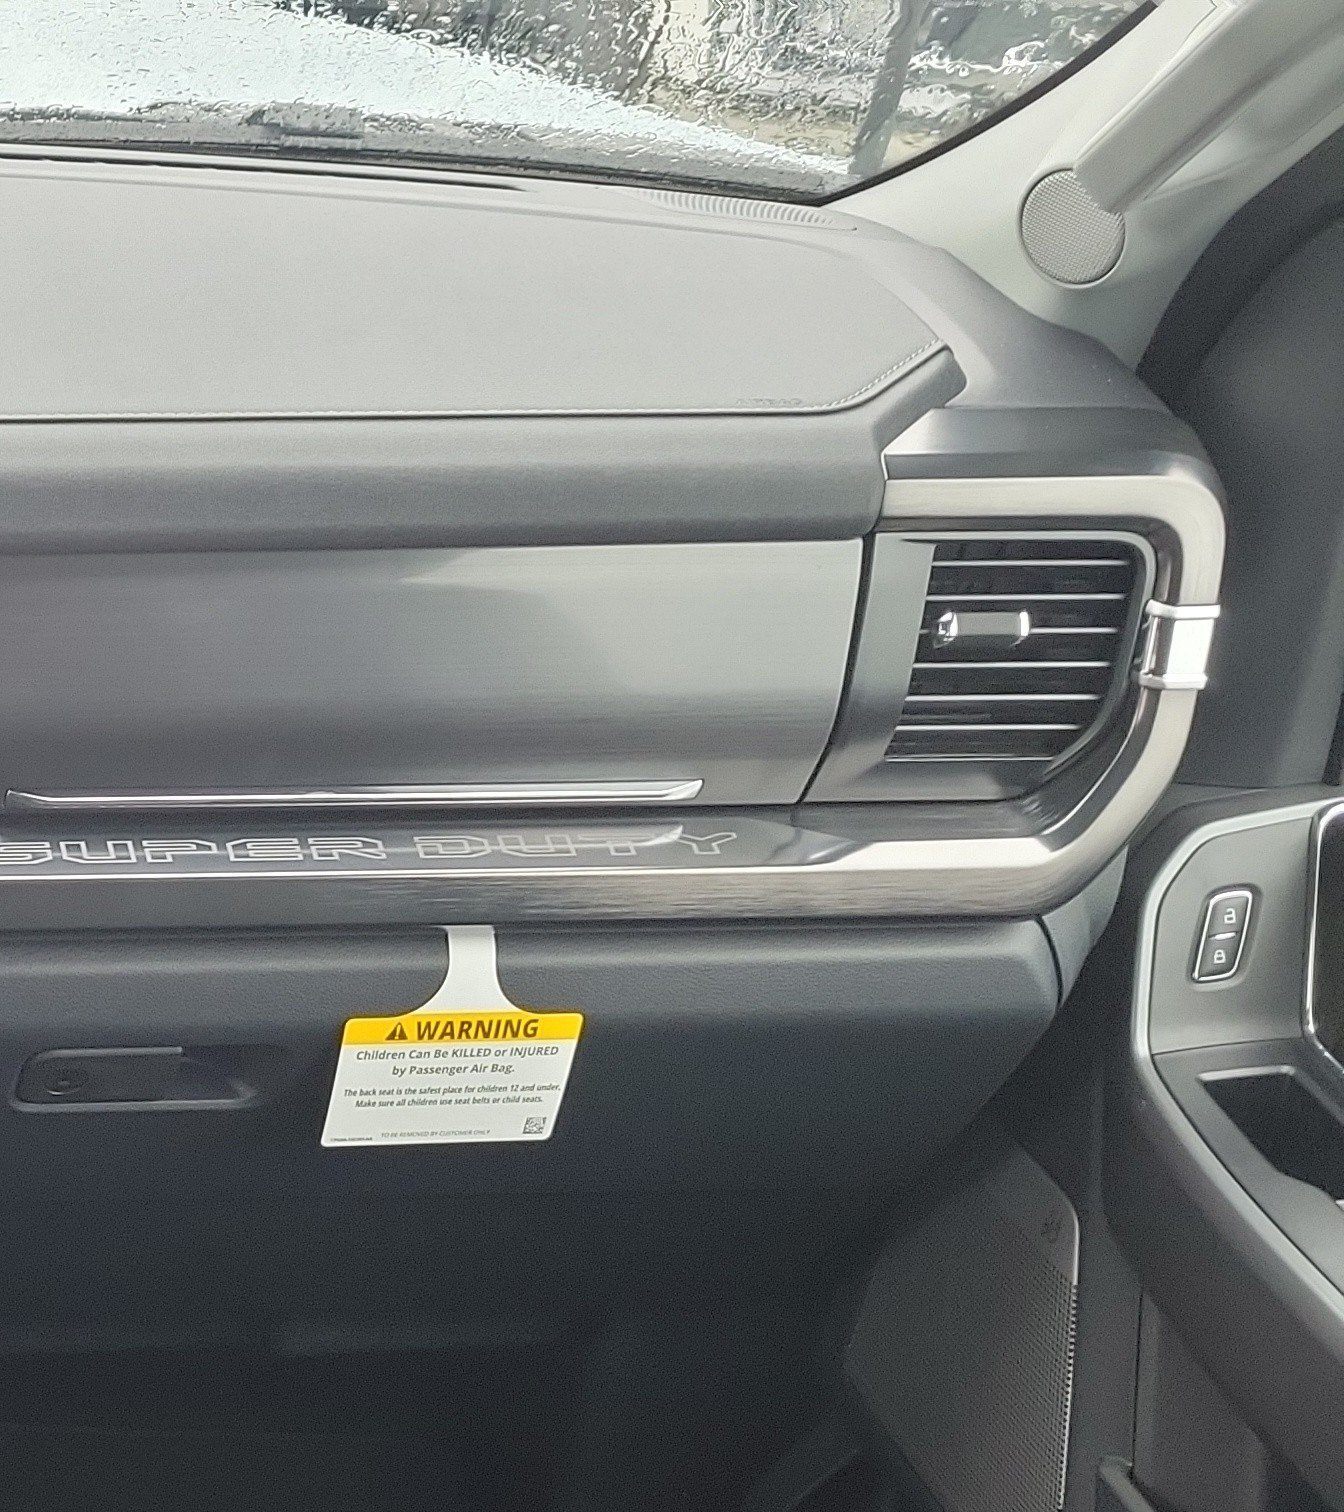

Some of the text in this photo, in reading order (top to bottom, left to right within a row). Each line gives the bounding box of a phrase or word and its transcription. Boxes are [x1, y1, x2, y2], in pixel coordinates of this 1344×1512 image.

[413, 832, 737, 860] DUTY
[416, 1018, 540, 1041] WARNING
[356, 1046, 559, 1061] Children Can Be KILLED or INJURED
[391, 1063, 515, 1078] by Passenger Air Bag.
[343, 1083, 561, 1097] The back seat is the safest place for children 12 and under.
[355, 1099, 377, 1108] Make
[395, 1098, 407, 1107] all
[407, 1098, 438, 1106] children
[453, 1097, 471, 1105] seat
[471, 1096, 490, 1105] belts
[502, 1095, 521, 1104] child
